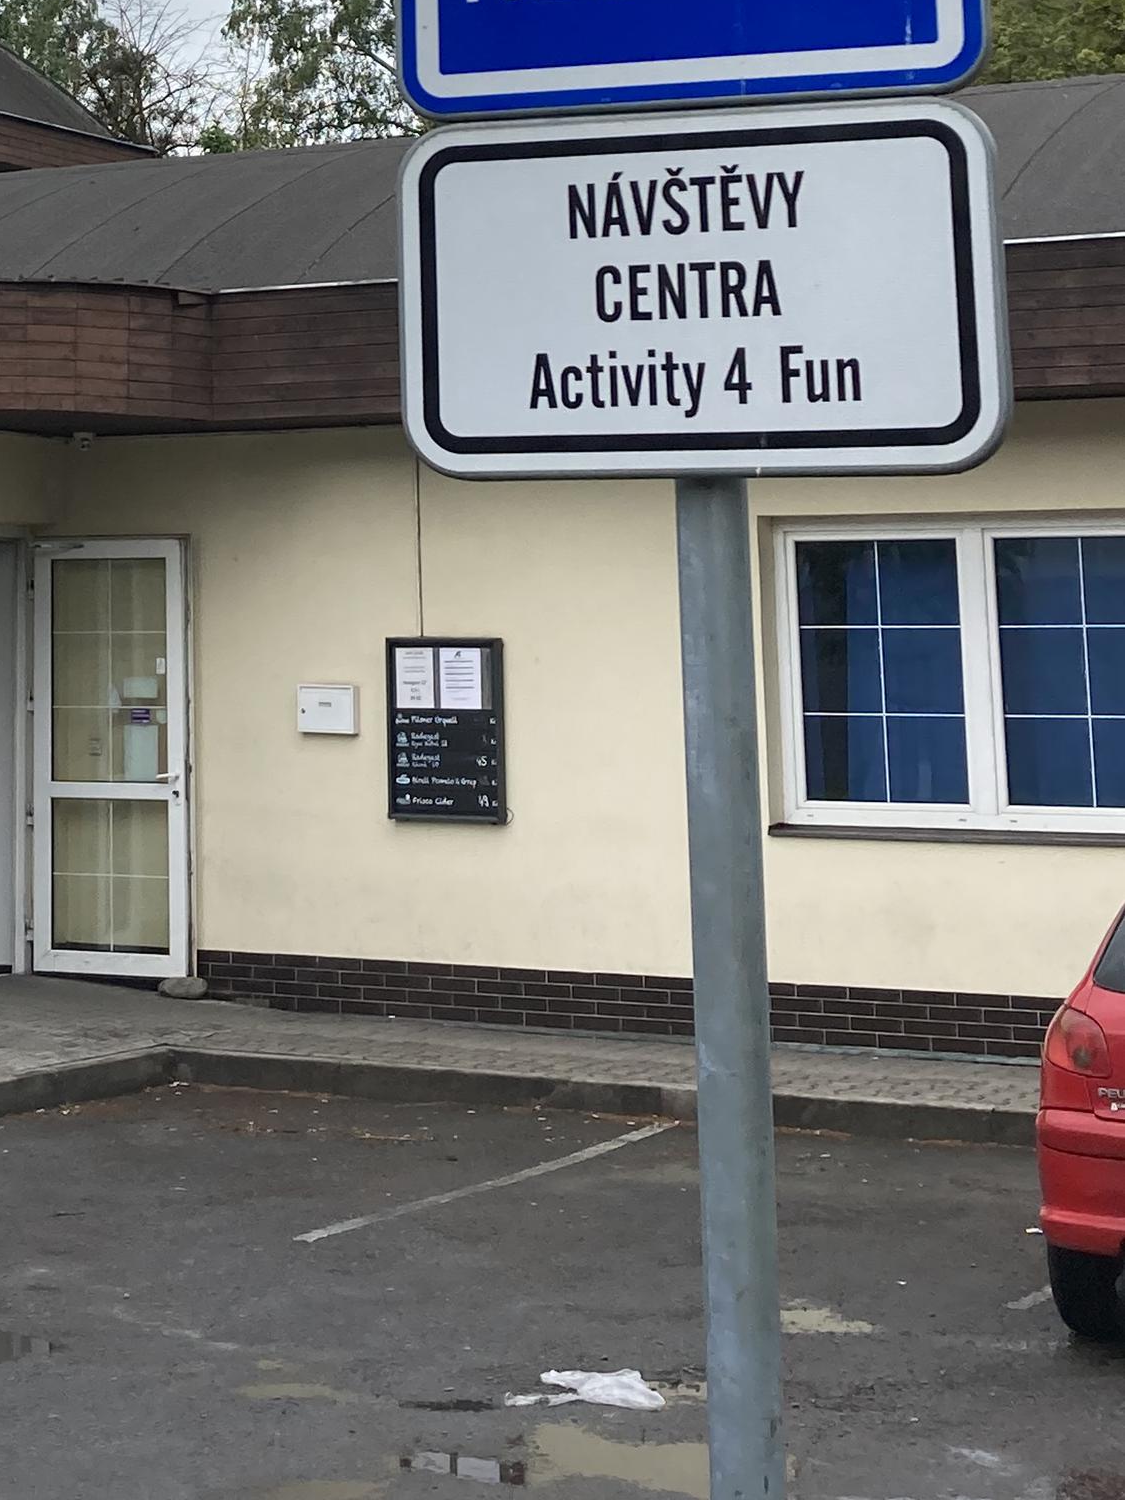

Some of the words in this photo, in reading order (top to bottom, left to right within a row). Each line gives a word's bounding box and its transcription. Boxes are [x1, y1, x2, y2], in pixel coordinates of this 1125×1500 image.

[568, 165, 805, 239] NÁVŠTĚVY
[595, 260, 783, 323] CENTRA
[529, 348, 707, 419] Activity
[724, 347, 753, 405] 4
[780, 345, 862, 404] Fun
